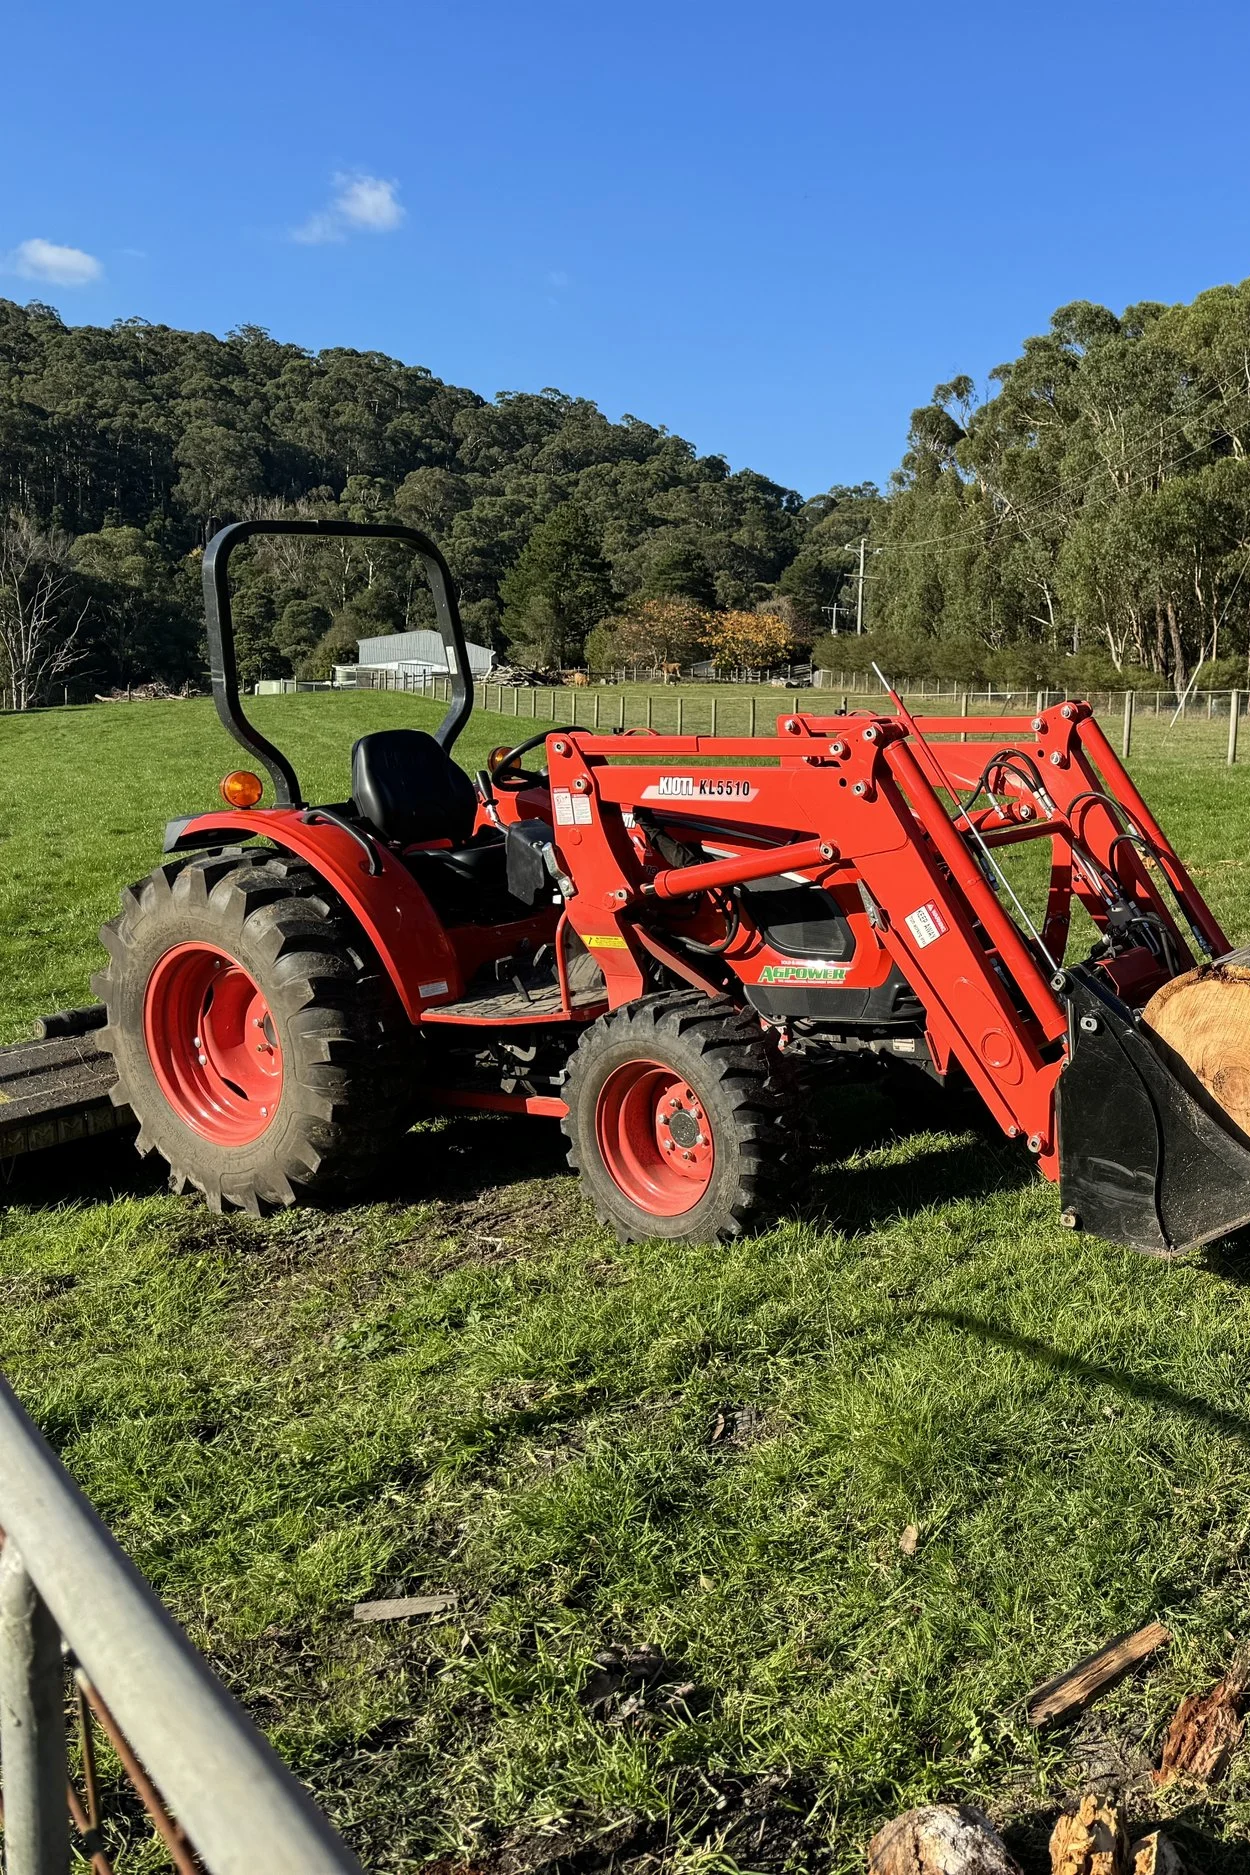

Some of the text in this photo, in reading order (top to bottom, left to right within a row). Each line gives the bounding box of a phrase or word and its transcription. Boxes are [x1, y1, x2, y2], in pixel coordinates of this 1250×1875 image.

[659, 776, 750, 796] KIOTI KL5510
[758, 966, 846, 983] AGPOWER
